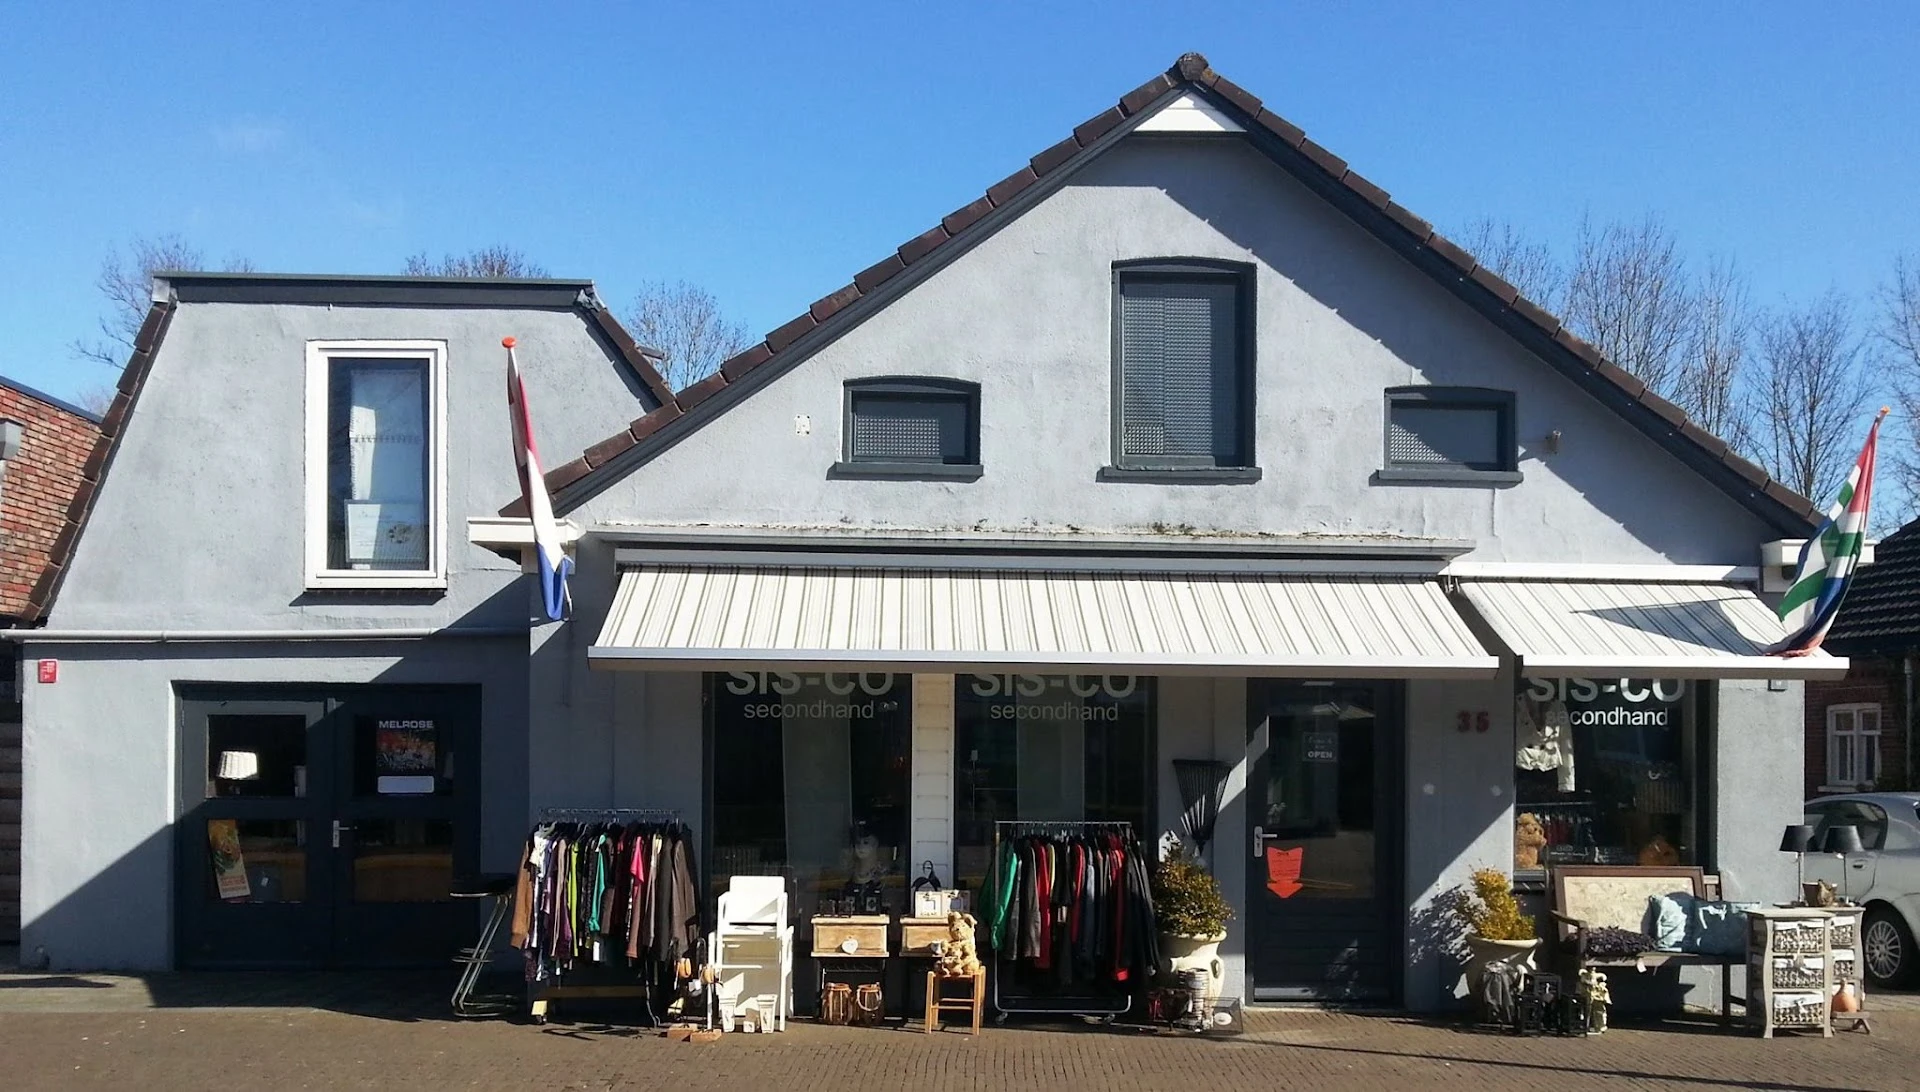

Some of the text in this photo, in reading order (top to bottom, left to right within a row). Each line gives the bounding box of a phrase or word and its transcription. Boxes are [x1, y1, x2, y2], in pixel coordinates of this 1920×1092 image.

[725, 672, 894, 696] SIS-CO
[971, 674, 1137, 698] SIS-CO
[1527, 678, 1685, 702] SIS-CO
[743, 700, 874, 719] secondhand
[990, 702, 1118, 721] secondhand
[378, 720, 434, 729] MELROSE
[1457, 711, 1490, 732] 35
[1307, 751, 1333, 759] OPEN
